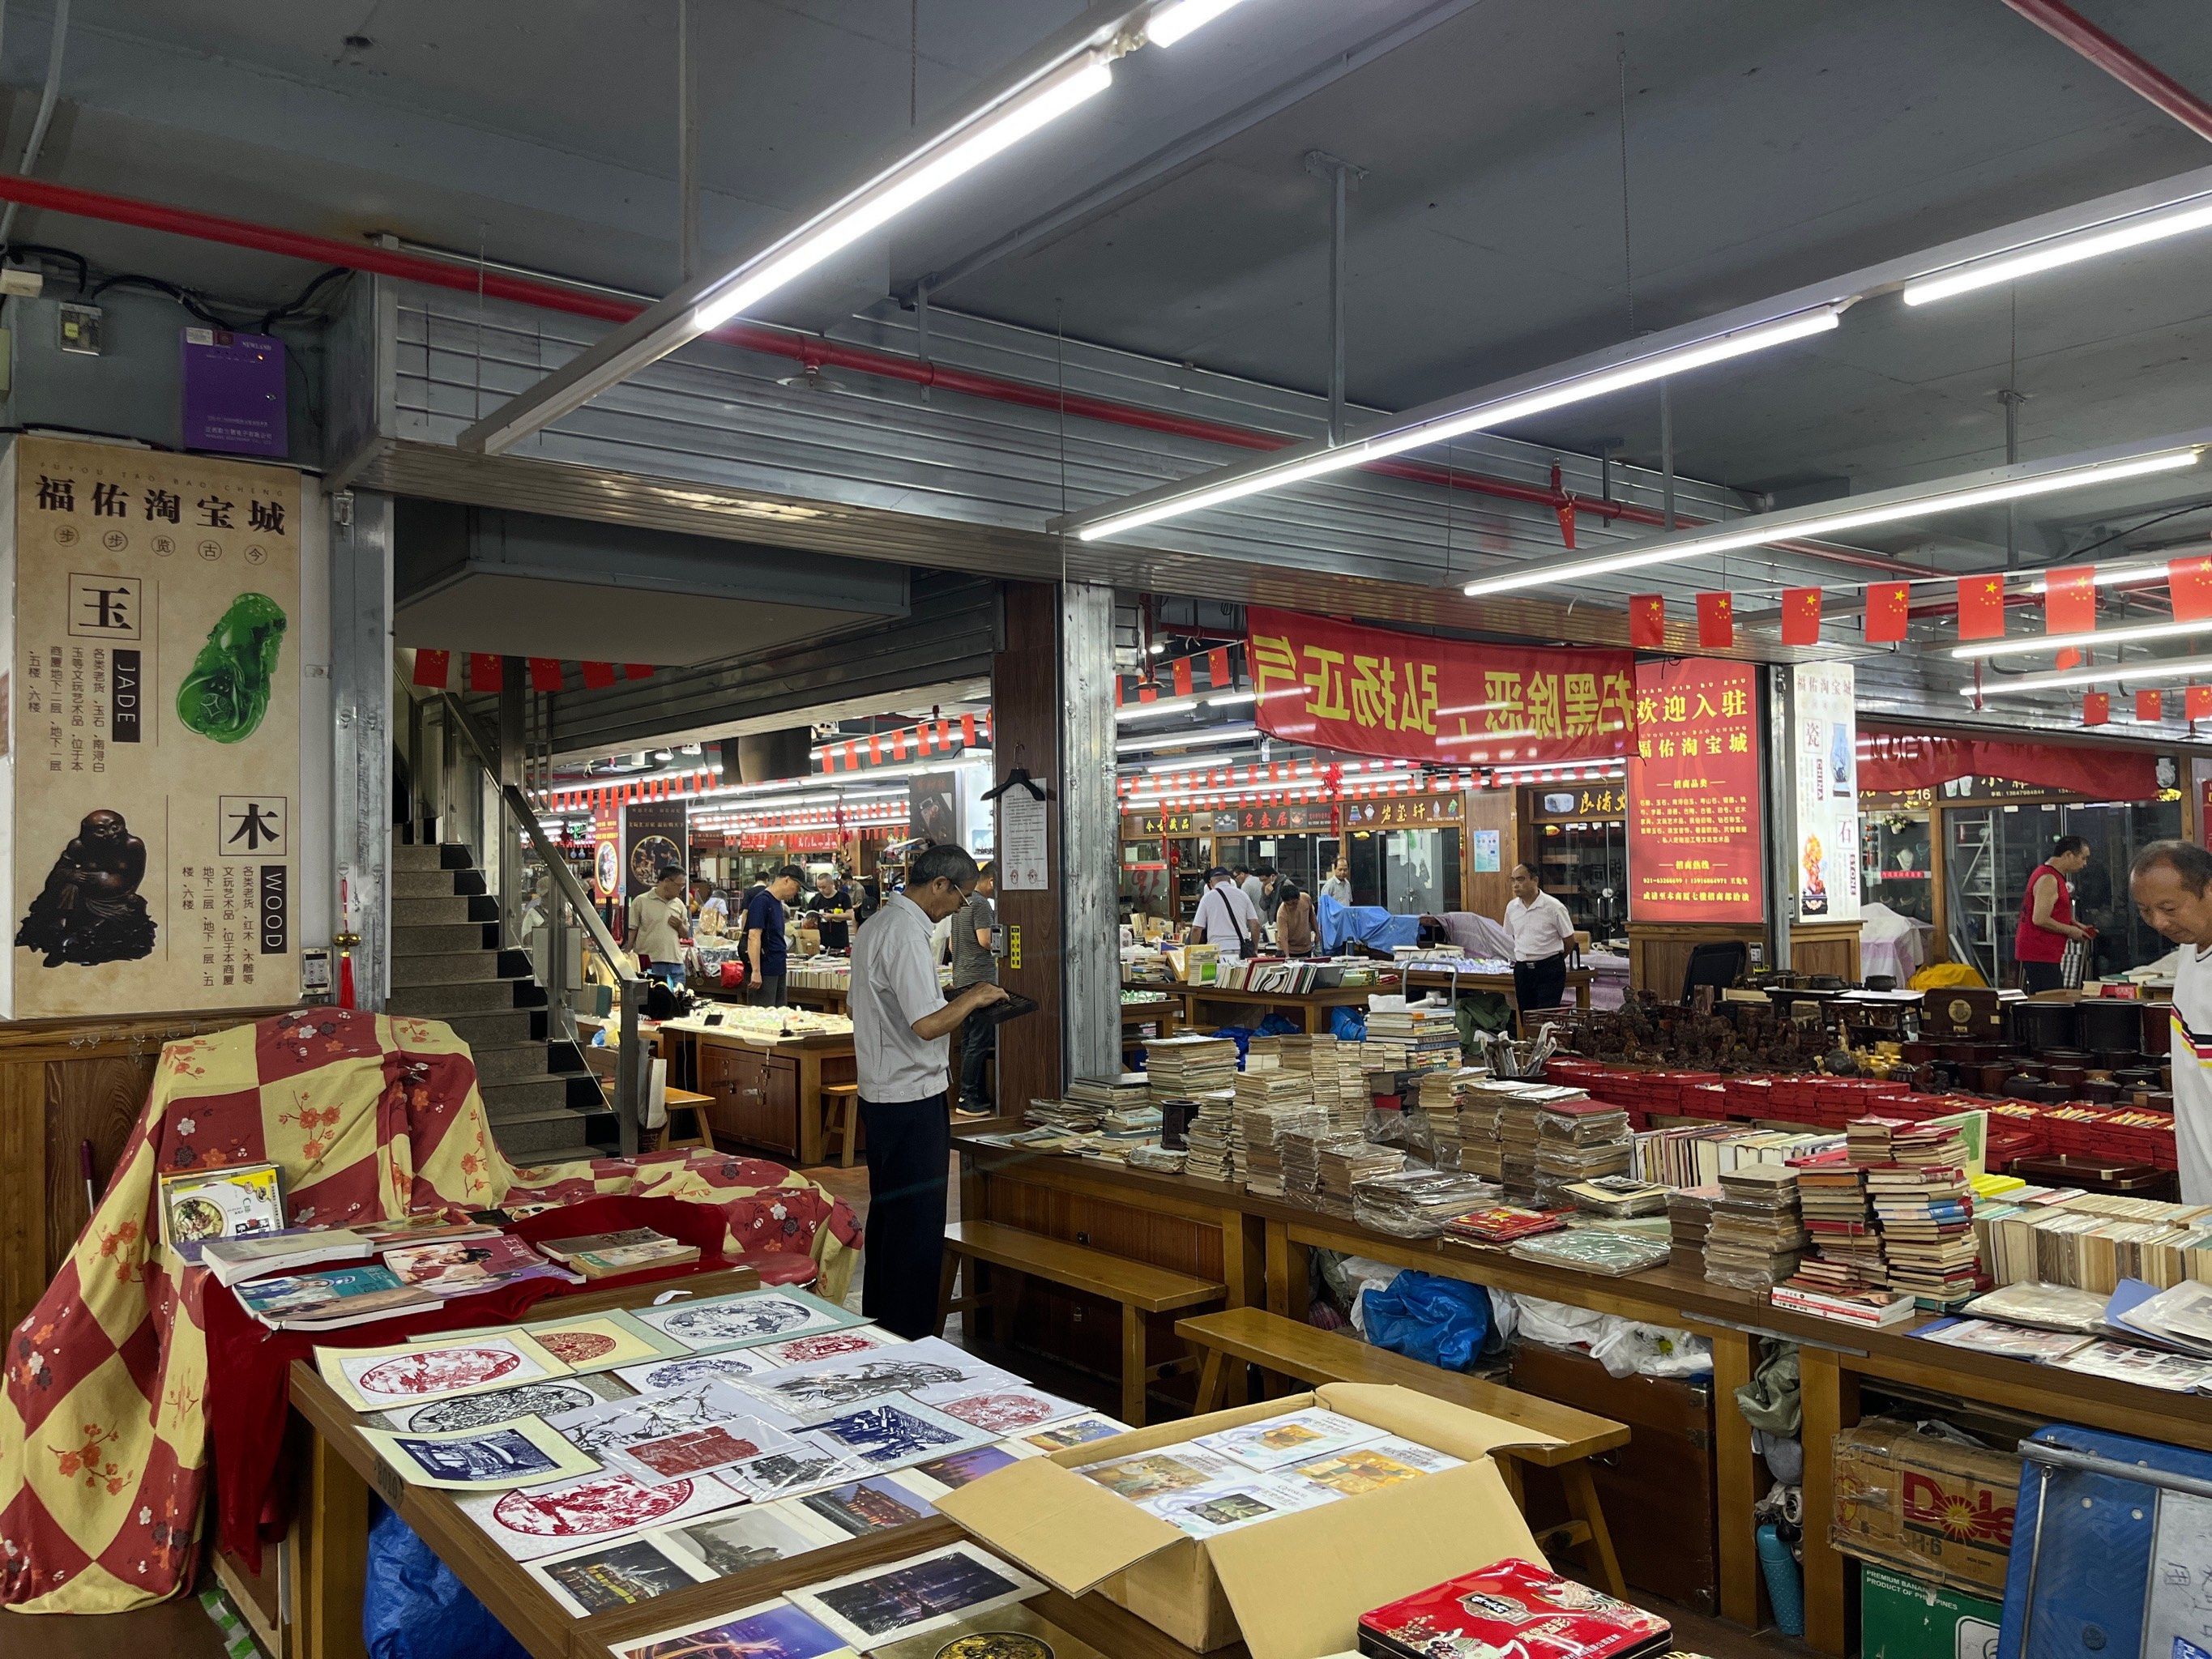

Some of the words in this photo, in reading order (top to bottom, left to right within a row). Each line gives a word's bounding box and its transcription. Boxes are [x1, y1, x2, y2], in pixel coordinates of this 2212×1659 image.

[35, 475, 285, 535] 福佑淘宝城
[54, 525, 268, 565] 步步览古今
[78, 586, 133, 630] 玉
[117, 663, 136, 723] JADE
[1637, 689, 1748, 725] 欢迎入驻
[1638, 731, 1748, 758] 福佑淘宝城
[1915, 789, 1931, 800] 16
[228, 804, 280, 851] 木
[1839, 820, 1852, 843] 石
[181, 866, 194, 911] 楼、六楼
[265, 872, 284, 949] WOOD
[1903, 1470, 2017, 1547] Dole
[1866, 1570, 1900, 1585] PREMIUM
[1901, 1577, 1932, 1593] BANAN
[1866, 1576, 1901, 1593] PRODUCT
[1902, 1589, 1912, 1597] OF
